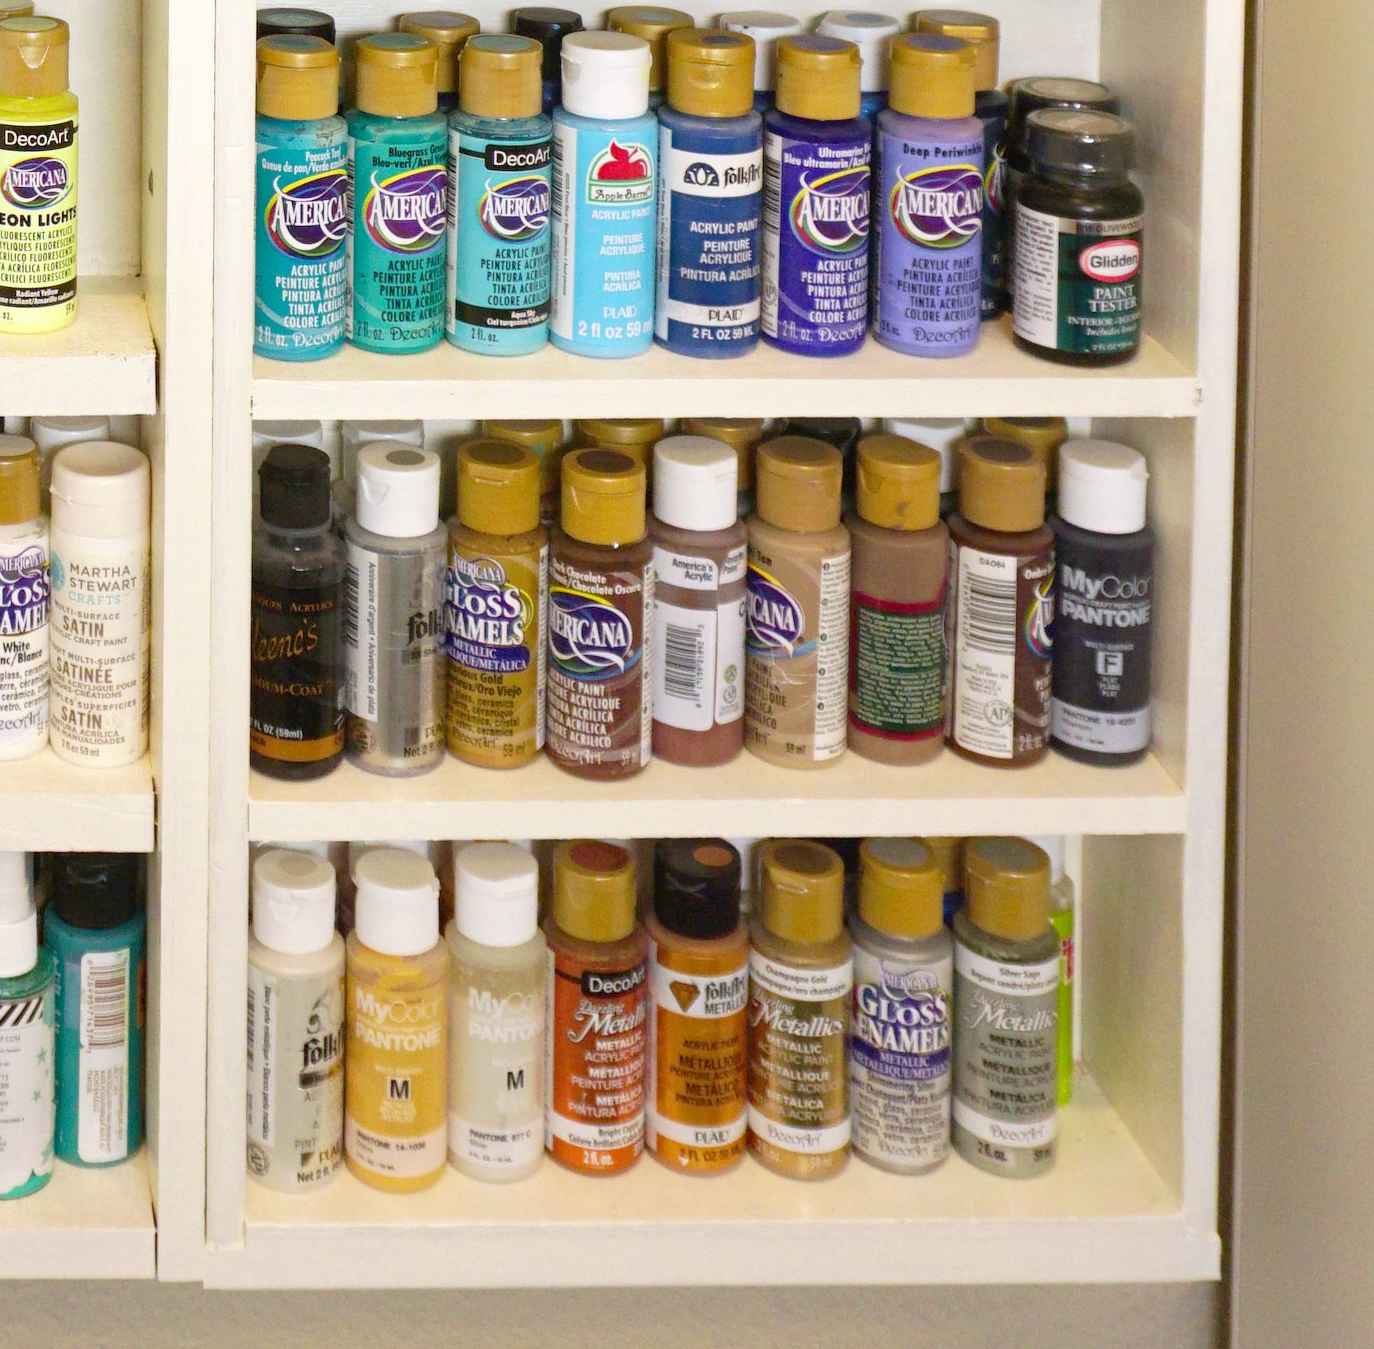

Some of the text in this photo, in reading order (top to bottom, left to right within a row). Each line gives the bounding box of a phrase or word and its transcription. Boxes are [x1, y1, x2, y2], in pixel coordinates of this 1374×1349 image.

[4, 129, 69, 147] DecoArt
[903, 143, 930, 158] Deep
[38, 205, 77, 227] LIGHTS
[1090, 253, 1139, 268] Glidden
[1094, 285, 1135, 300] PAINT
[1089, 298, 1138, 313] TESTER
[709, 309, 742, 322] PLAID
[70, 563, 131, 576] MARTHA
[69, 577, 137, 592] STEWART
[3, 641, 30, 654] White
[480, 674, 503, 684] Gold
[857, 984, 948, 1026] GLOSS
[390, 1080, 409, 1099] M
